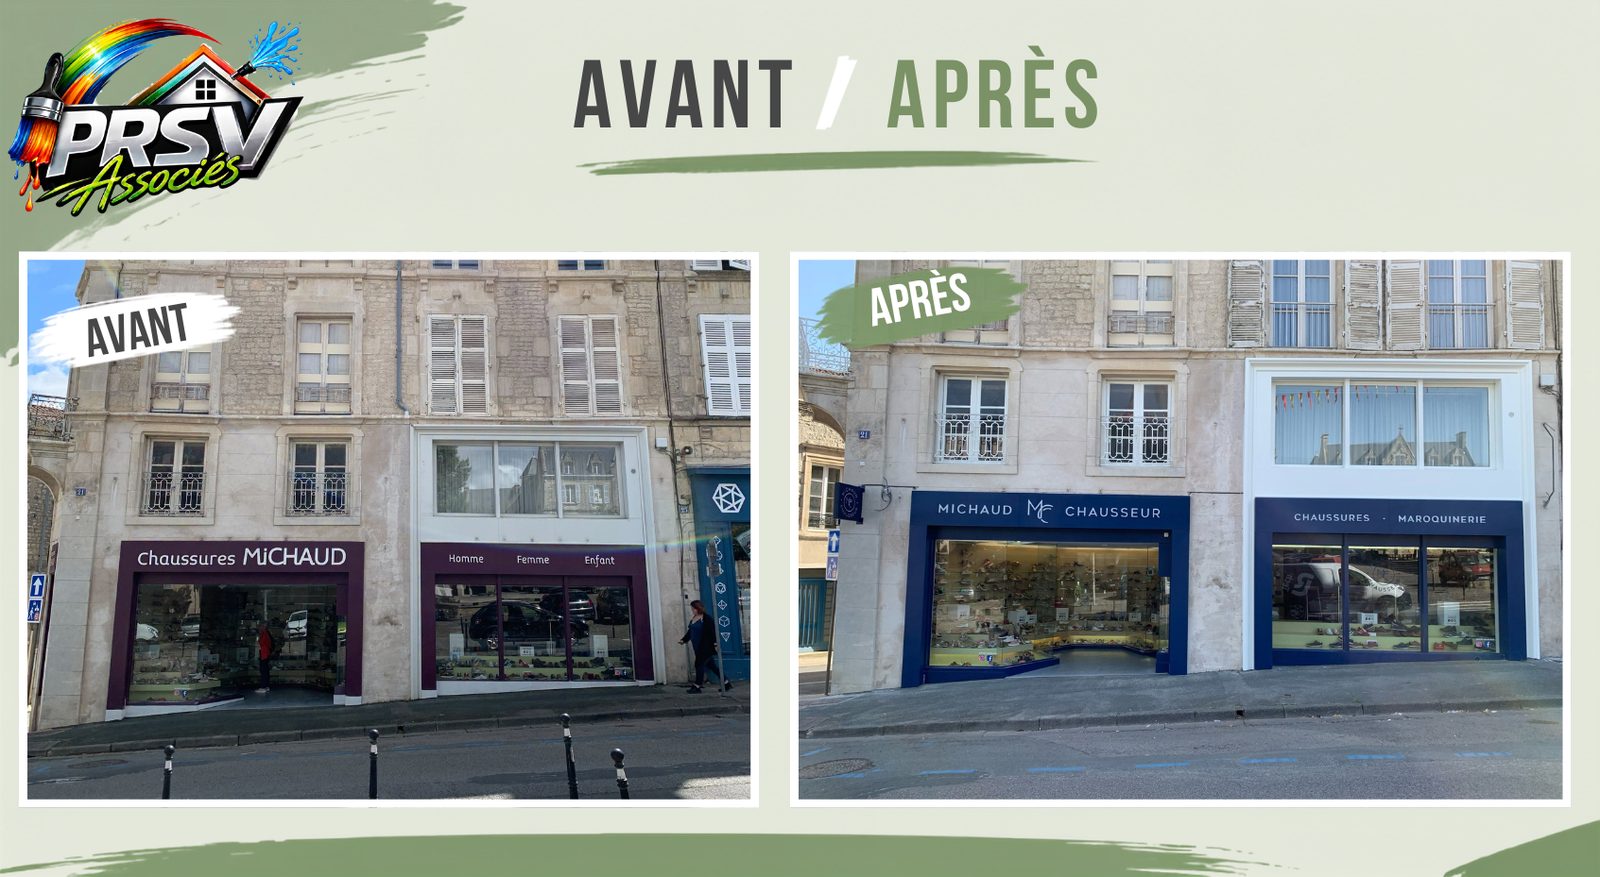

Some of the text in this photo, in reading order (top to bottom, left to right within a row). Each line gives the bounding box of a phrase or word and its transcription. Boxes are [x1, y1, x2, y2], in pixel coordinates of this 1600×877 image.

[938, 503, 1013, 516] MICHAUD
[1065, 506, 1161, 519] CHAUSSEUR
[1294, 513, 1487, 524] CHAUSSURES MAROQUINERIE
[137, 549, 236, 566] Chaussures
[448, 554, 616, 568] Homme Femme Enfant
